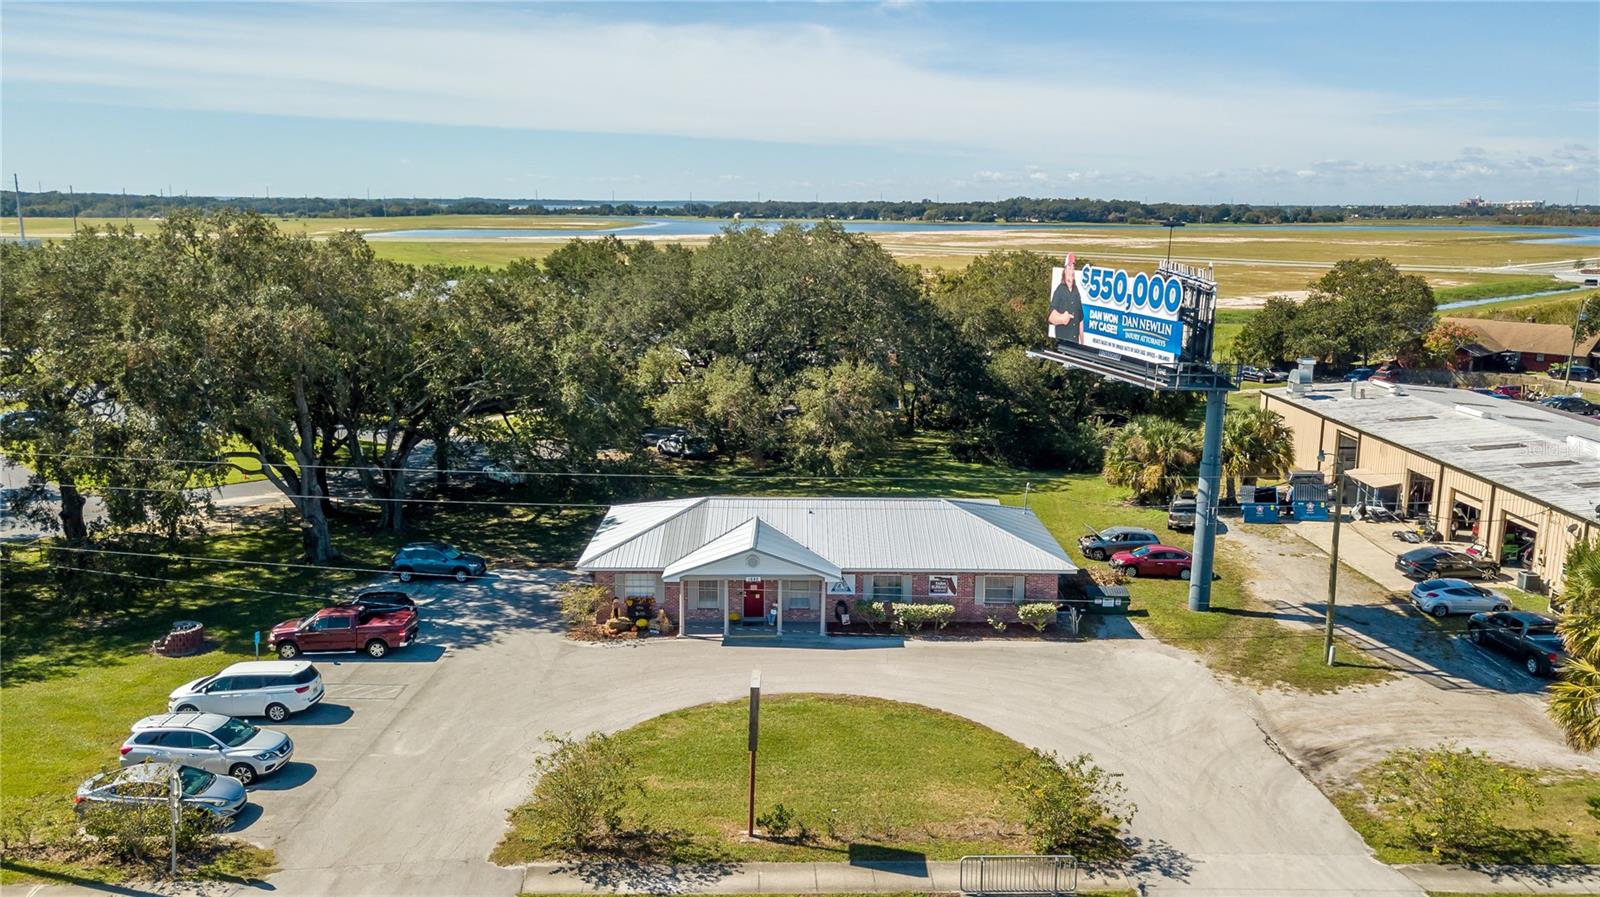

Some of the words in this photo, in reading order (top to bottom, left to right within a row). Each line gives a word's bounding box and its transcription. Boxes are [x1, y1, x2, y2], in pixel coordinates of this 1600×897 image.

[1082, 265, 1181, 312] $550,000
[1089, 309, 1102, 320] DAN
[1103, 312, 1118, 324] WON
[1088, 319, 1099, 330] MY
[1121, 315, 1139, 328] DAN
[1139, 320, 1172, 335] NEWLIN
[1139, 335, 1166, 347] ATTORNEYS
